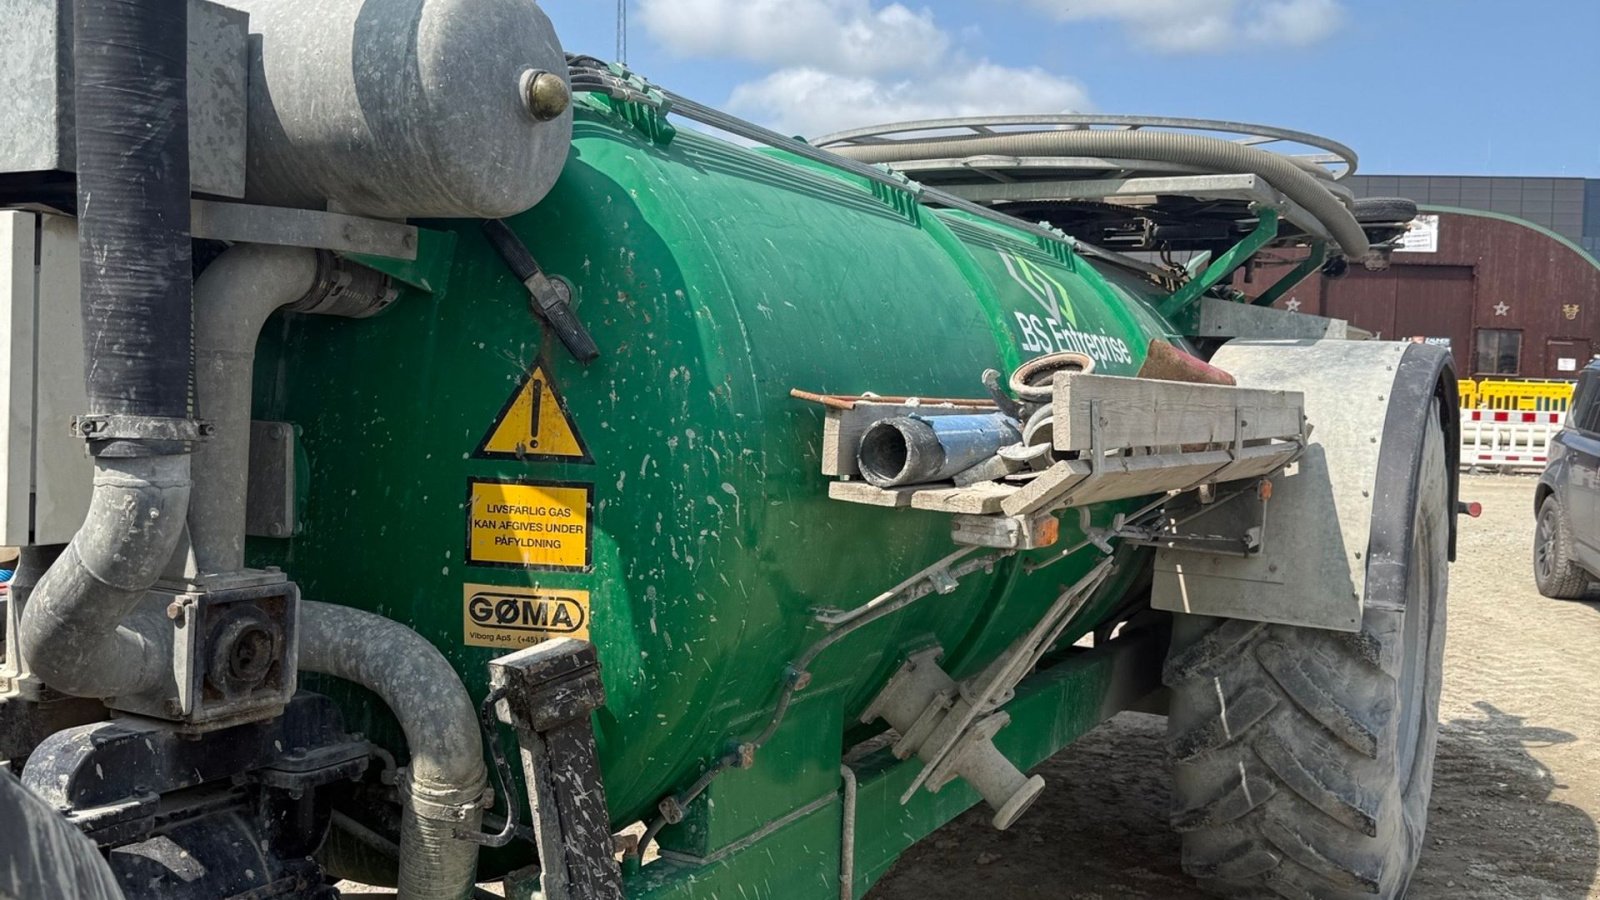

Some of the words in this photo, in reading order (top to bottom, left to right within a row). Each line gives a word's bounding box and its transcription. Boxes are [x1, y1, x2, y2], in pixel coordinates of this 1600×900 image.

[1045, 317, 1132, 370] Entreprise
[487, 504, 546, 517] LIVSFARLIG
[549, 508, 571, 517] GAS
[474, 520, 496, 529] KAN
[499, 521, 543, 531] AFGIVES
[546, 524, 583, 534] UNDER
[495, 536, 561, 549] PÅFYLDNING
[469, 597, 573, 627] GØMA
[469, 632, 495, 642] Viborg
[496, 634, 512, 642] ApS
[518, 635, 539, 645] (+45)
